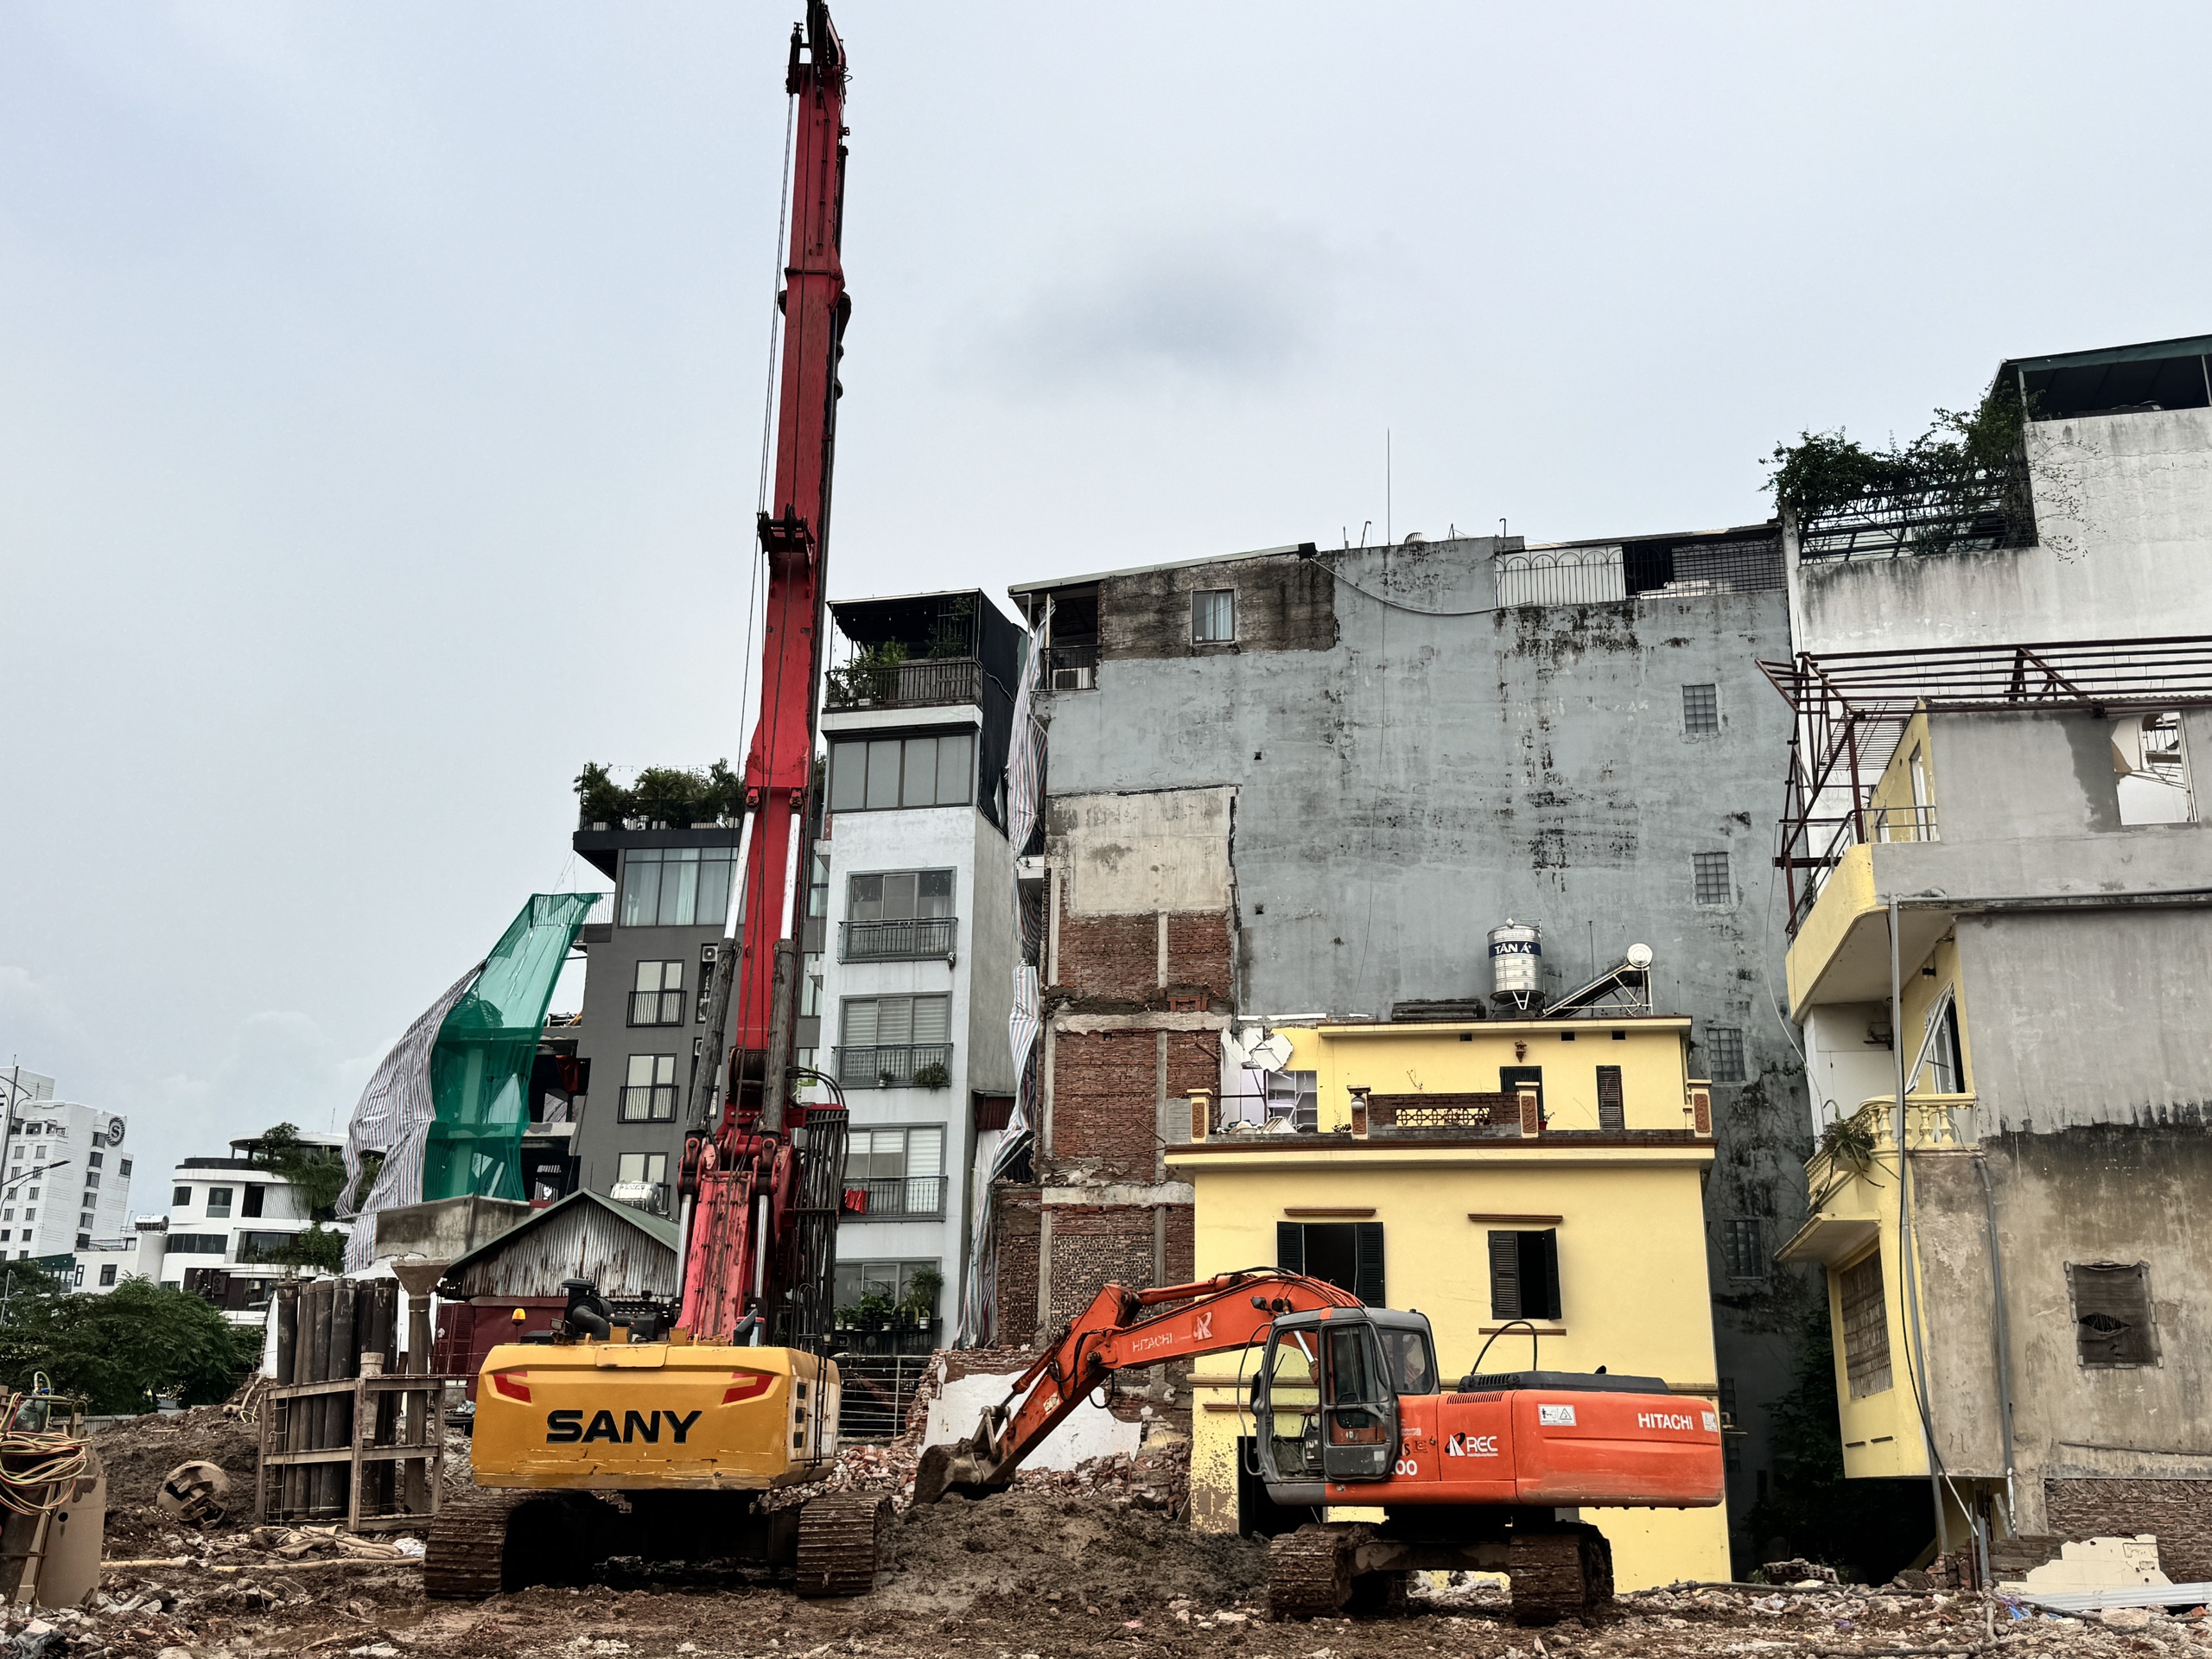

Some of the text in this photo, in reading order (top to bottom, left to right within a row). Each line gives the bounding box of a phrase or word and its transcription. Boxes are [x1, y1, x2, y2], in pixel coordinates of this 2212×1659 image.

[1132, 1332, 1173, 1352] HITACHI
[546, 1409, 702, 1445] SANY
[1637, 1413, 1694, 1430] HITACHI
[1466, 1435, 1498, 1452] REC
[1391, 1459, 1417, 1476] 00
